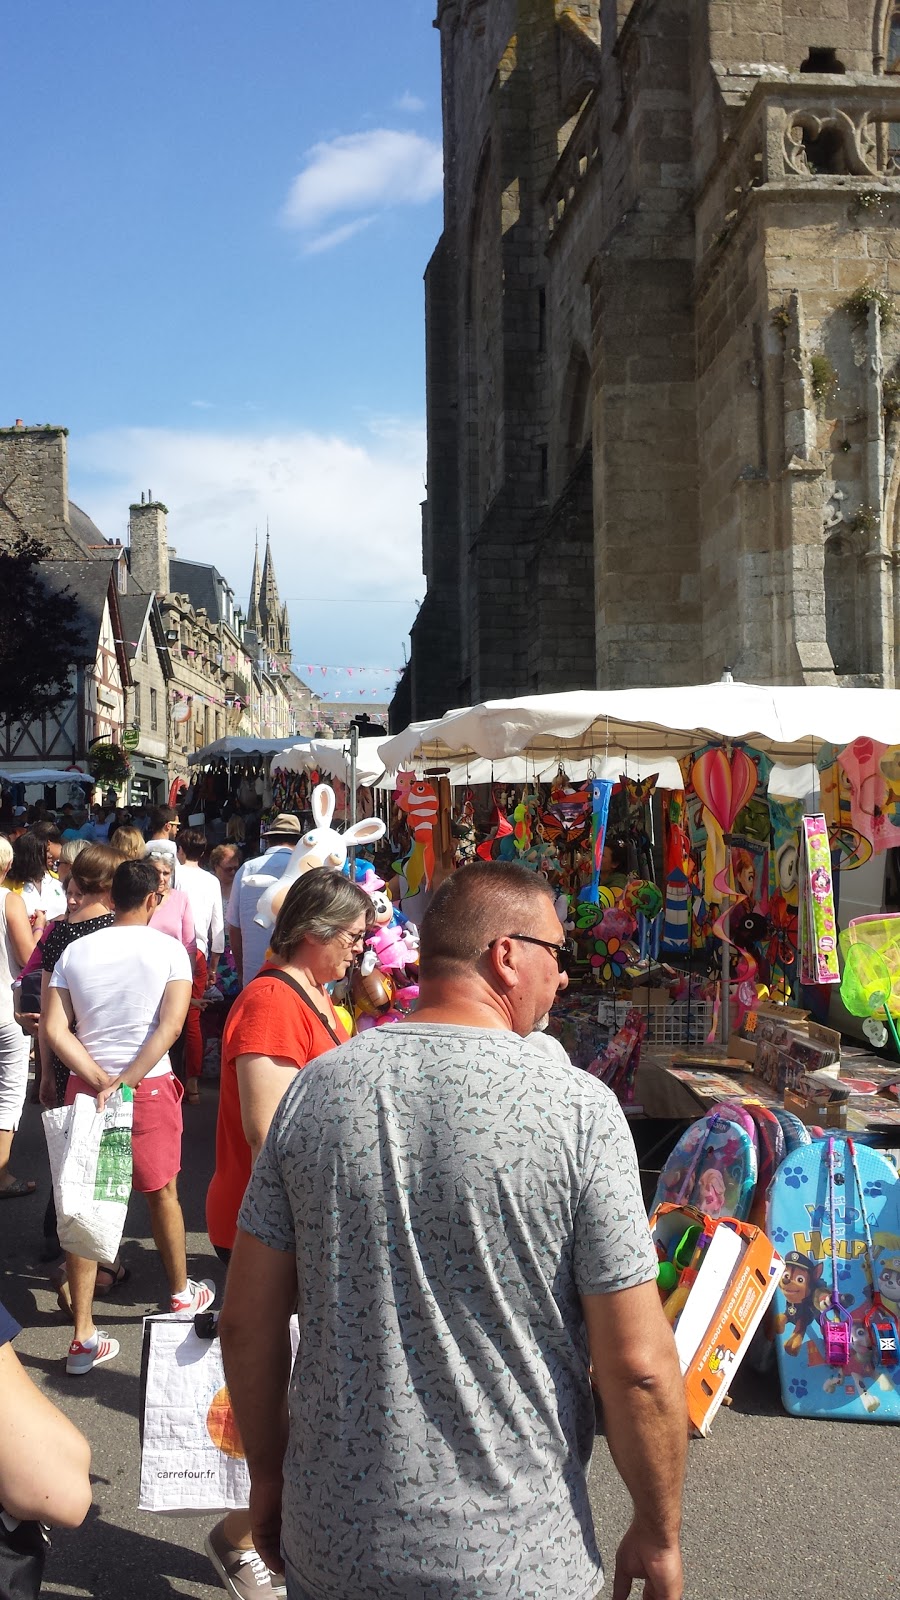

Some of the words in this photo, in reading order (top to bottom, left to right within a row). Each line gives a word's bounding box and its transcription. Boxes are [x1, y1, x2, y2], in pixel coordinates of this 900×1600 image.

[697, 1361, 705, 1372] LE
[703, 1345, 713, 1361] BON
[722, 1313, 729, 1325] DE
[726, 1300, 736, 1315] NOS
[157, 1469, 215, 1479] carrefour.fr
